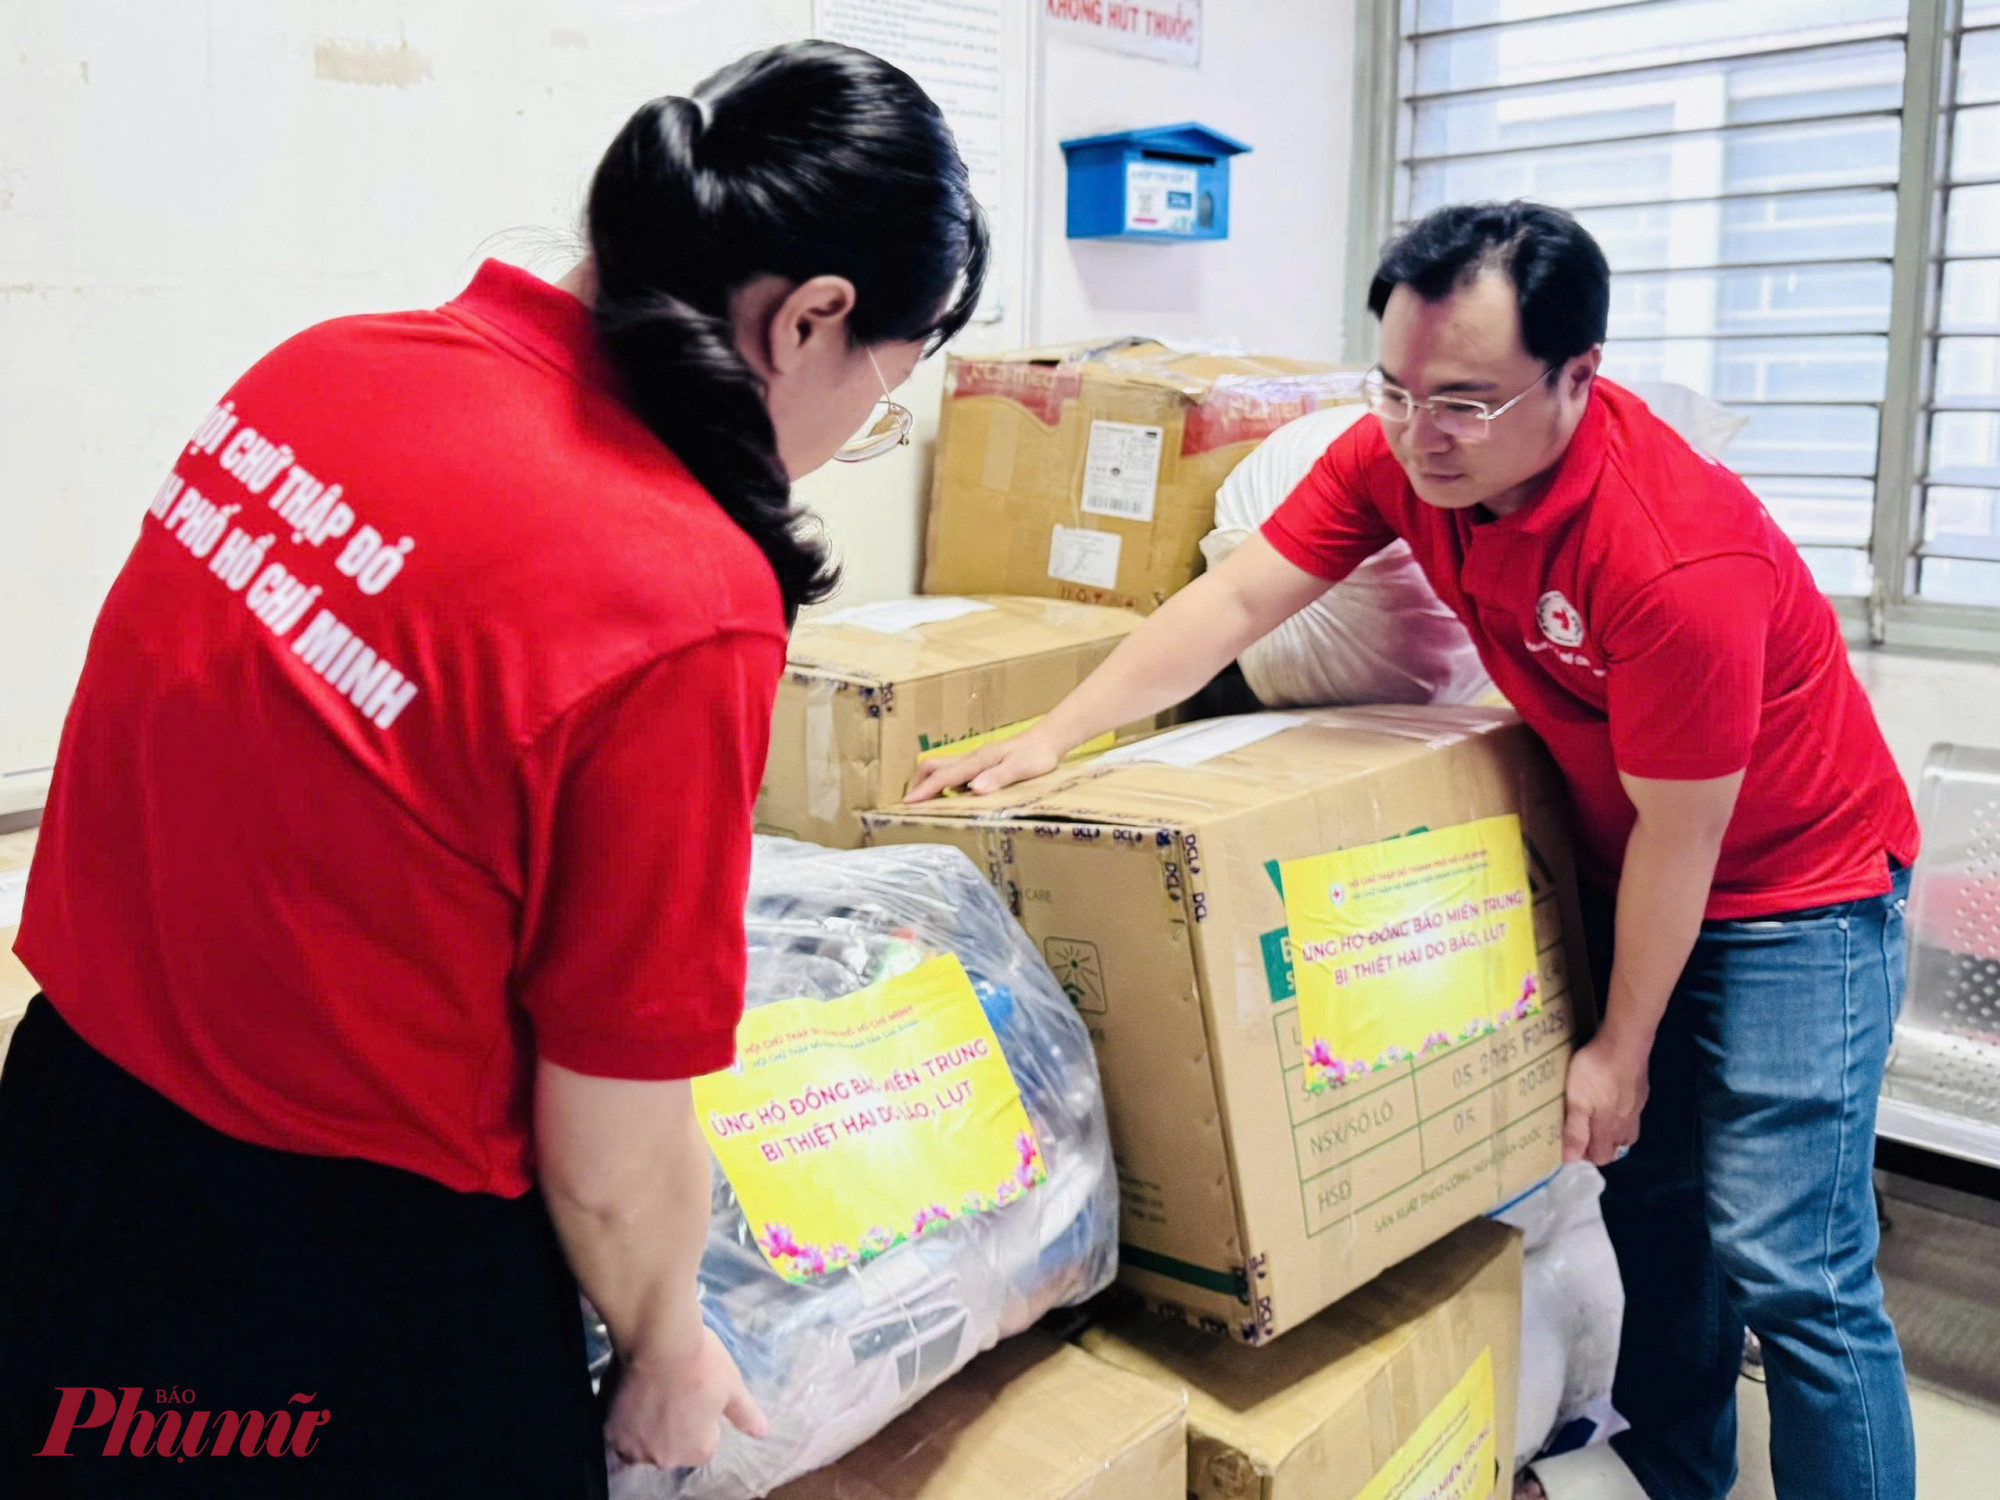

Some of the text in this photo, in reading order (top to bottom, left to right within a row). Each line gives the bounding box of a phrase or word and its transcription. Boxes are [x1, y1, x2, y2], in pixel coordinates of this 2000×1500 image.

[189, 401, 414, 595] ỘI CHỮ THẬP ĐỎ
[164, 487, 241, 559] PHỐ
[246, 563, 323, 637] CHÍ
[291, 608, 418, 730] MINH
[1483, 889, 1525, 914] TRUNG
[1424, 941, 1446, 960] DO
[710, 1110, 755, 1137] ỨNG
[756, 1098, 786, 1127] HỘ
[788, 1083, 850, 1117] ĐỒNG
[850, 1076, 880, 1096] BÀ
[922, 1038, 988, 1077] TRUNG
[783, 1121, 839, 1156] THIỆT
[841, 1108, 878, 1137] HẠI
[935, 1079, 973, 1111] LỤT
[1318, 1179, 1352, 1212] HSD
